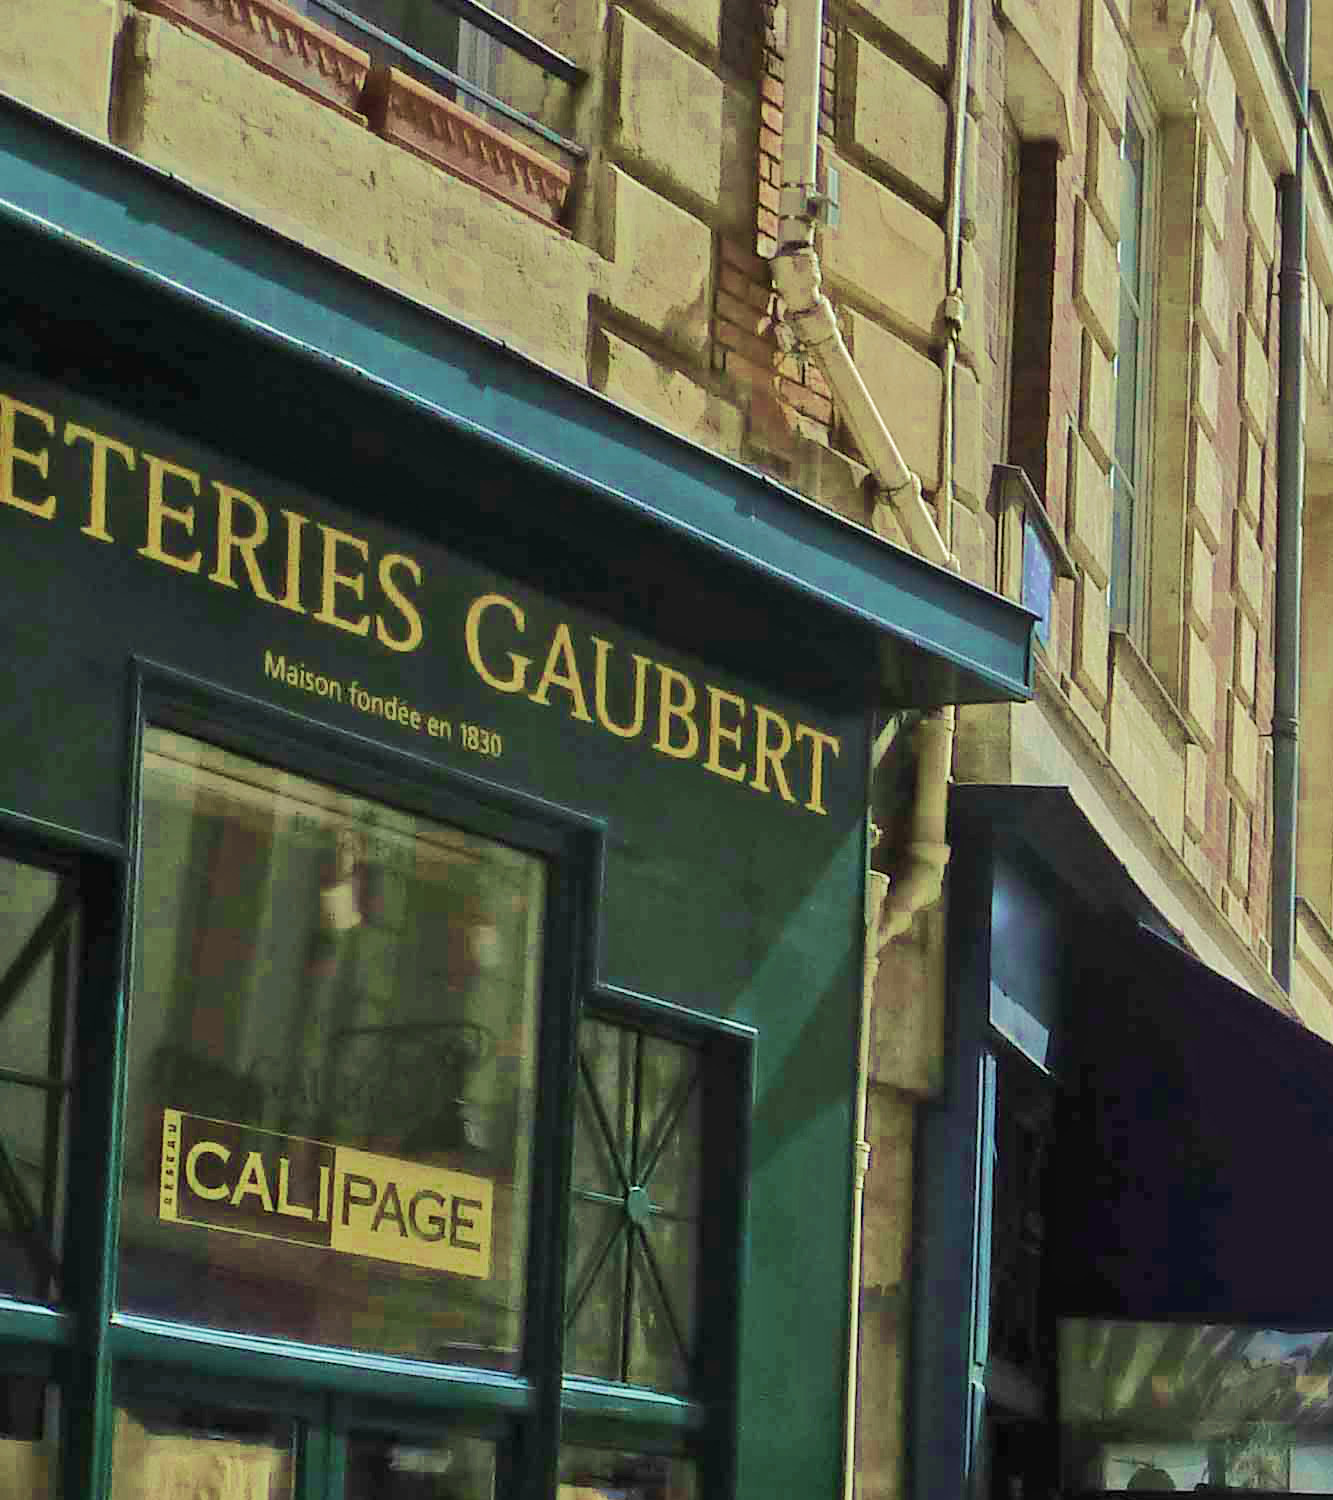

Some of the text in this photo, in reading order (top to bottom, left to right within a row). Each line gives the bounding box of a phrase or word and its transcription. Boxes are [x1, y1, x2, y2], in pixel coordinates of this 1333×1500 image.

[264, 650, 503, 757] Maison fondée en 1830
[464, 593, 840, 815] GAUBERT
